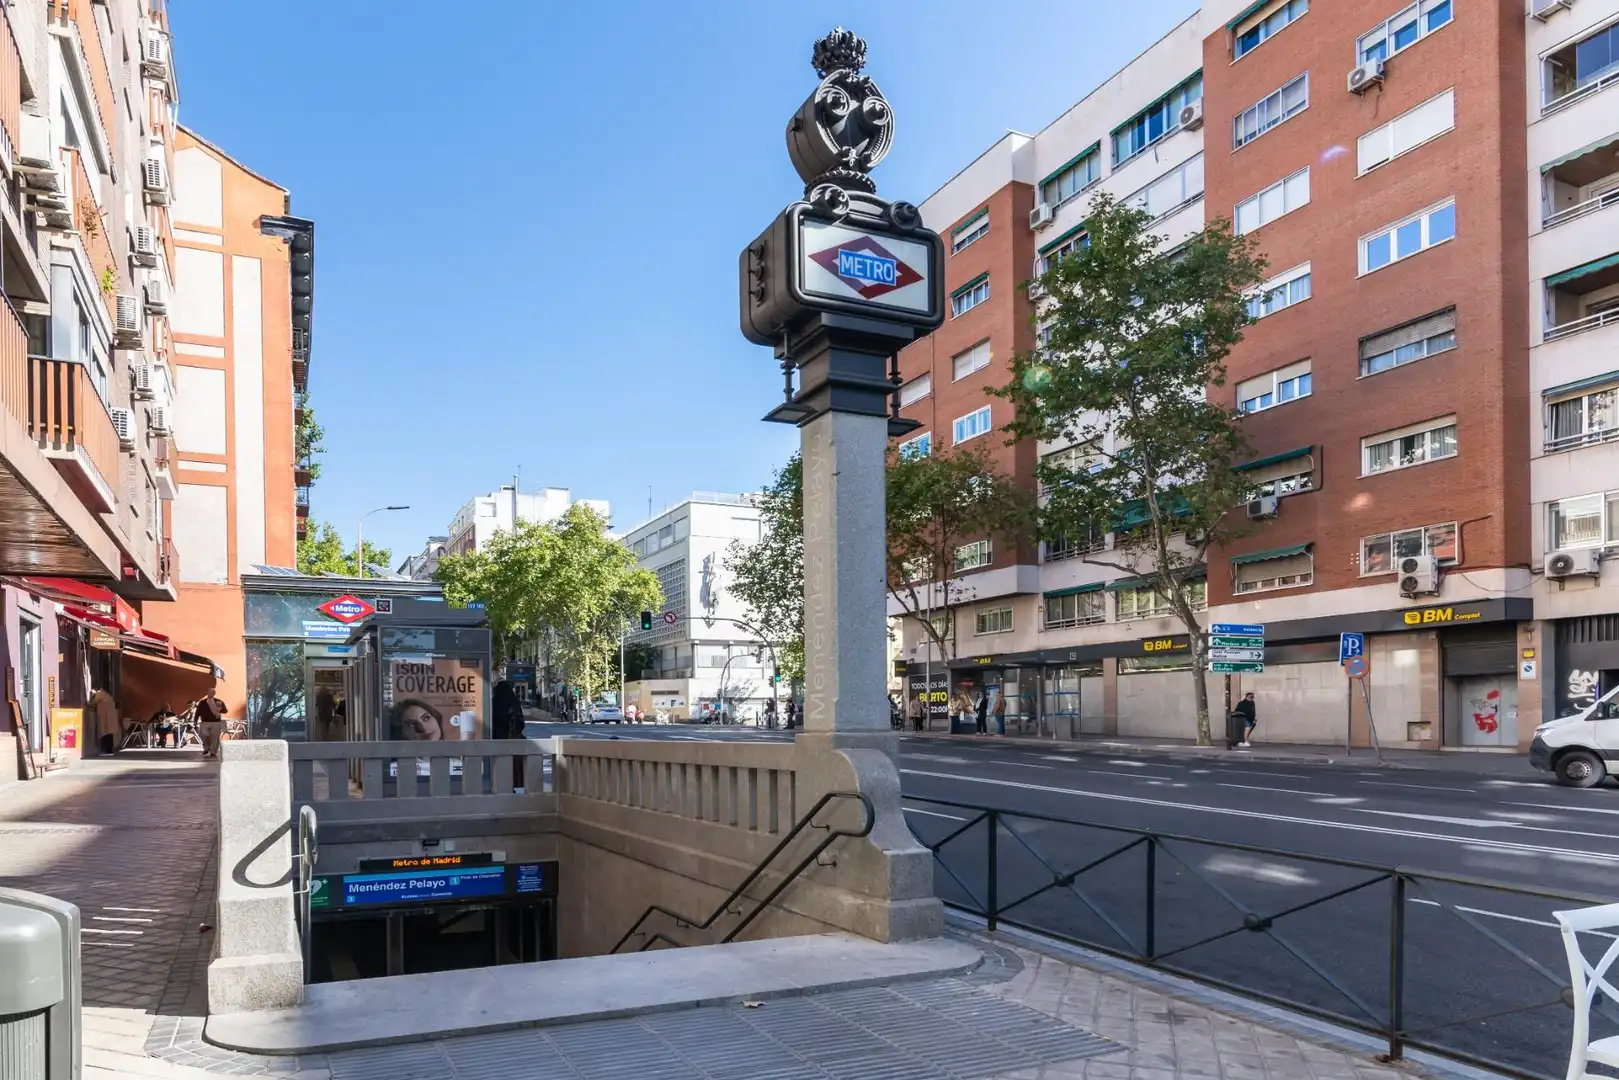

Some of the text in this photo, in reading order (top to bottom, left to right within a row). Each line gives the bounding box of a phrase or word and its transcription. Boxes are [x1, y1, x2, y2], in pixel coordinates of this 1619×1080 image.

[841, 254, 894, 282] METRO
[808, 432, 829, 541] Pelayo
[1423, 607, 1453, 623] BM
[1155, 640, 1172, 651] BM
[1346, 637, 1360, 656] P
[396, 663, 436, 675] ISDIN
[396, 676, 476, 693] COVERAGE
[911, 682, 928, 690] TODOS
[919, 691, 948, 702] BIRTO
[393, 856, 461, 867] Metro de Madrid
[348, 879, 446, 893] Menéndez Pelayo
